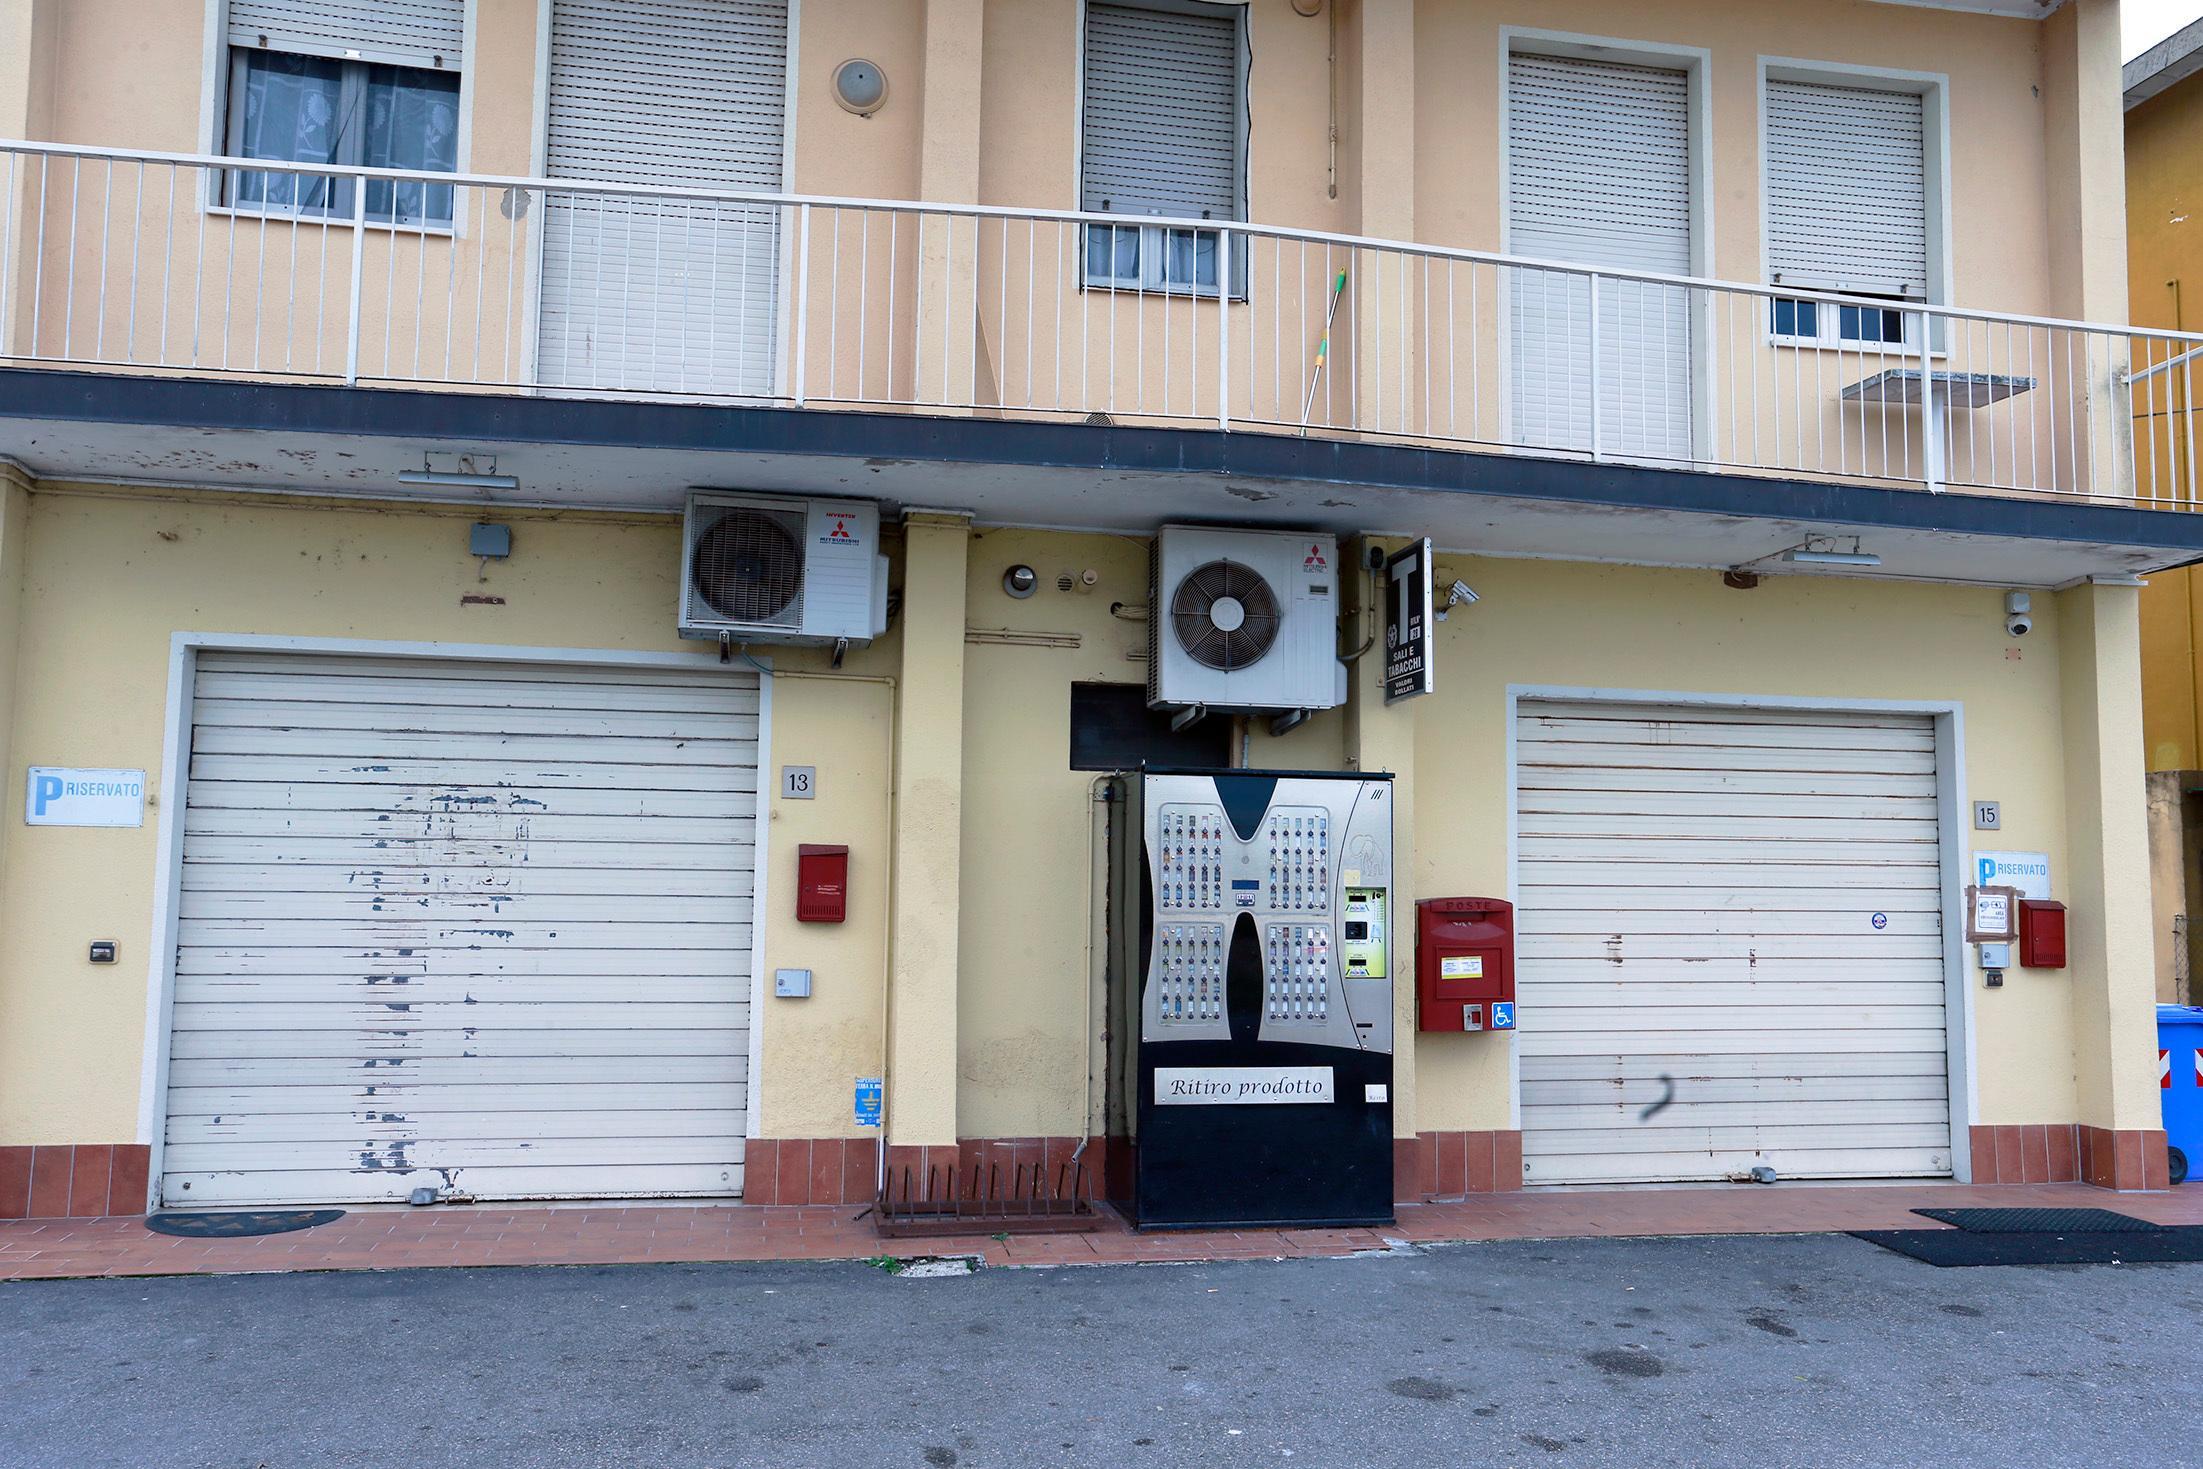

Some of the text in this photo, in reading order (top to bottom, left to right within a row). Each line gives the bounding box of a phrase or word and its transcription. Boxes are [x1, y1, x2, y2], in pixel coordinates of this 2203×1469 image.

[1392, 553, 1417, 645] T
[1393, 645, 1414, 662] SALI E
[1388, 656, 1421, 678] TABACCHI
[66, 782, 139, 797] RISERVATO
[789, 774, 808, 792] 13
[1980, 807, 1995, 823] 15
[1998, 863, 2046, 876] RISERVATO
[1446, 901, 1491, 910] POSTE
[1170, 1076, 1323, 1100] Ritiro prodotto
